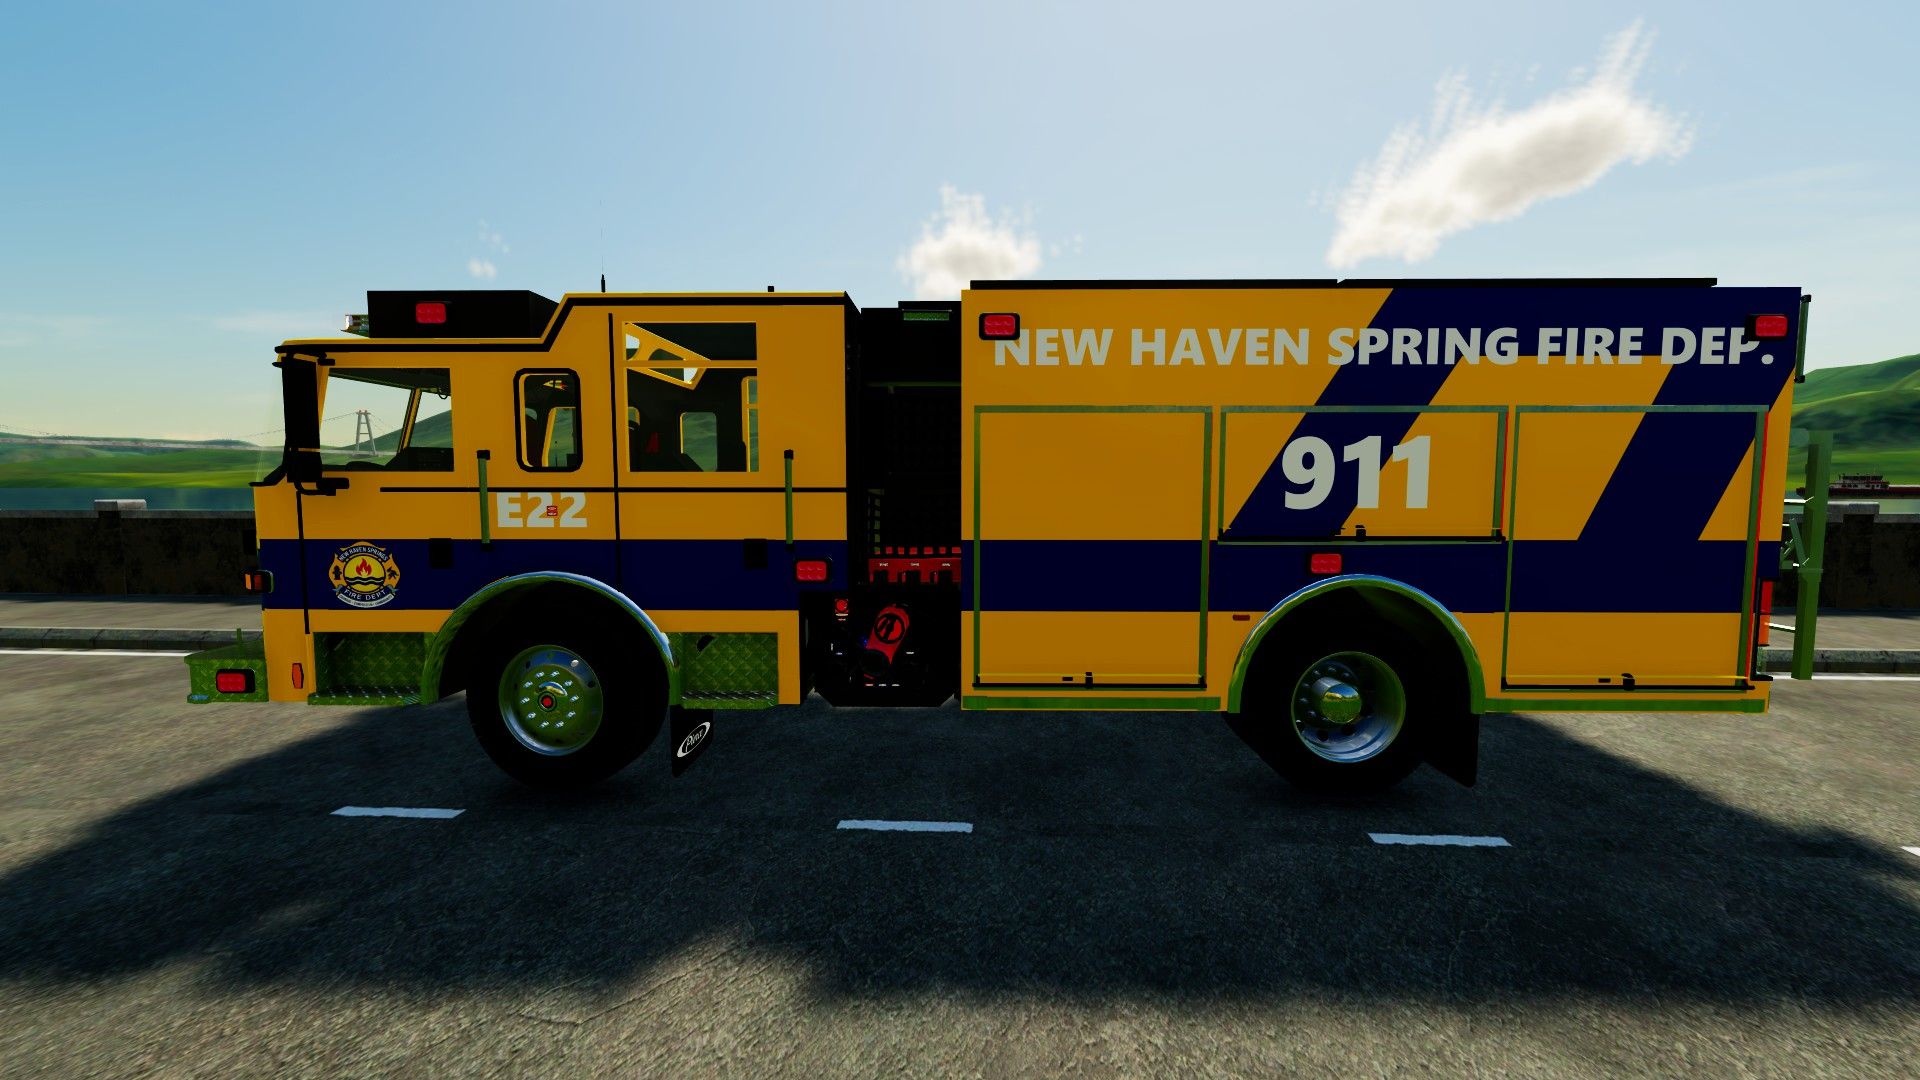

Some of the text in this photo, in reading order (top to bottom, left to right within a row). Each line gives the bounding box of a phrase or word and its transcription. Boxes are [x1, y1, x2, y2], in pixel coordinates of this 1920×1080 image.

[994, 328, 1114, 366] NEW
[1130, 328, 1310, 366] HAVEN
[1327, 327, 1519, 366] SPRING
[1537, 327, 1644, 365] FIRE
[1281, 435, 1431, 510] 911
[496, 491, 588, 528] E22
[367, 547, 388, 561] SPRINGS
[344, 589, 362, 600] FIRE
[365, 590, 386, 601] DEPT
